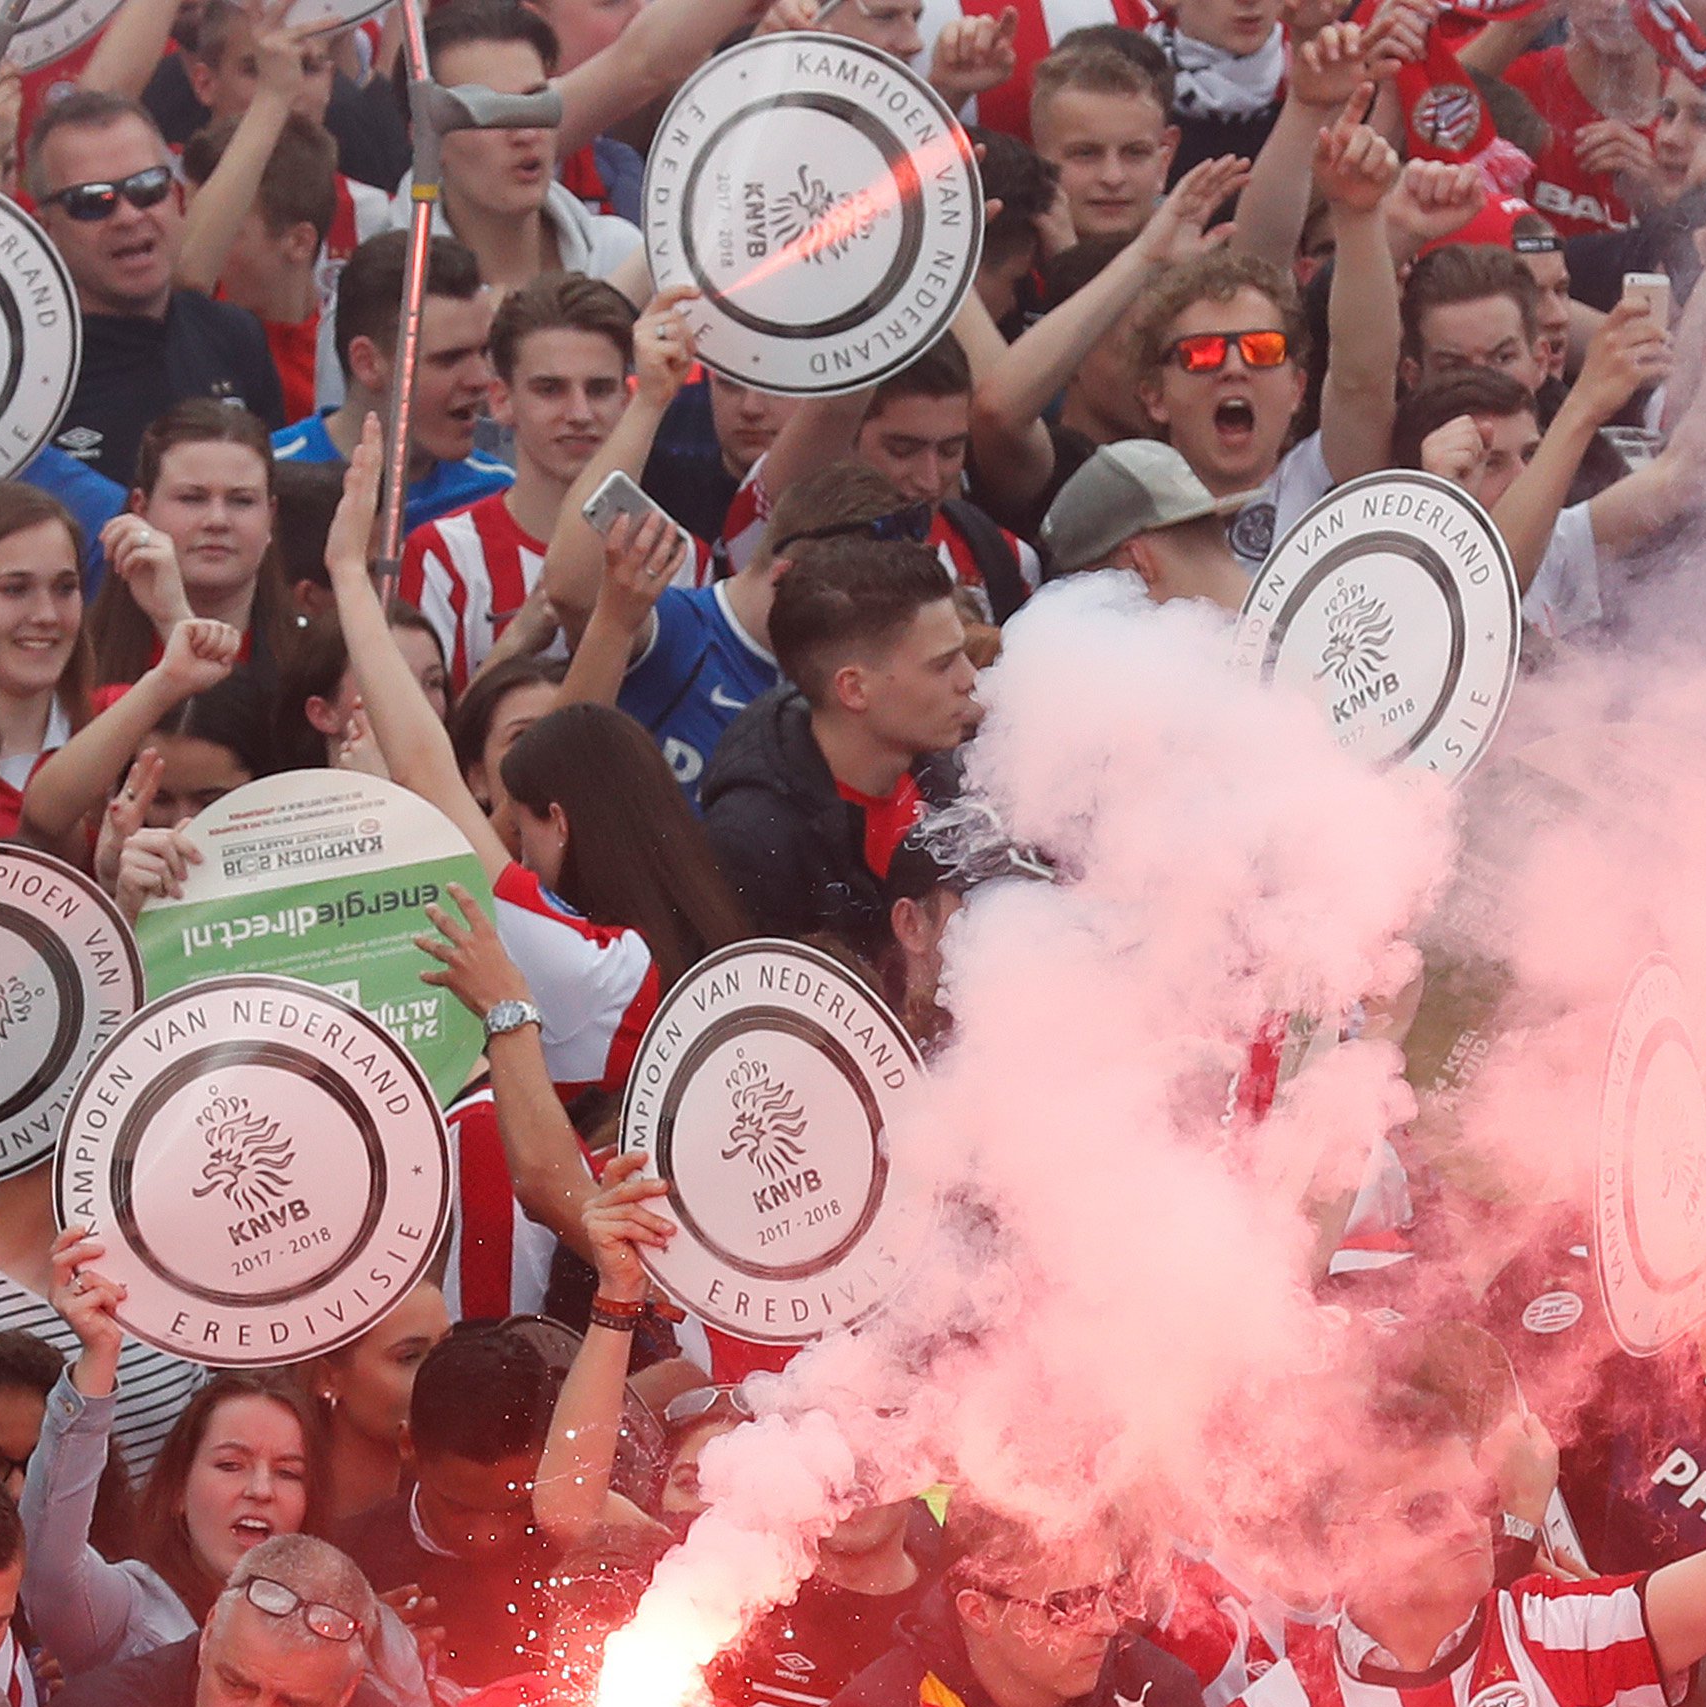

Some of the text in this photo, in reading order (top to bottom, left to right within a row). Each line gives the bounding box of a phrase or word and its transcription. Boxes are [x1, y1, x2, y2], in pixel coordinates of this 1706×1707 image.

[743, 182, 767, 258] KNVB
[796, 52, 963, 376] KAMPIOEN VAN NEDERLAND
[1295, 494, 1491, 586] VAN NEDERLAND
[1331, 672, 1401, 724] KNVB
[1378, 698, 1416, 727] 2018
[276, 835, 383, 868] KAMPIOEN
[182, 883, 439, 957] energiedirect.nl
[84, 929, 121, 987] VAN
[379, 997, 438, 1025] ALTIJ
[411, 1017, 438, 1038] 24
[143, 999, 411, 1119] VAN NEDERLAND
[632, 964, 906, 1149] MPIOEN VAN NEDERLAND
[751, 1168, 823, 1214] KNVB
[226, 1200, 312, 1246] KNVB
[757, 1199, 843, 1248] 2017 2018
[232, 1227, 333, 1277] 2017 2018
[170, 1221, 423, 1347] EREDIVISIE
[775, 1669, 810, 1683] umbro
